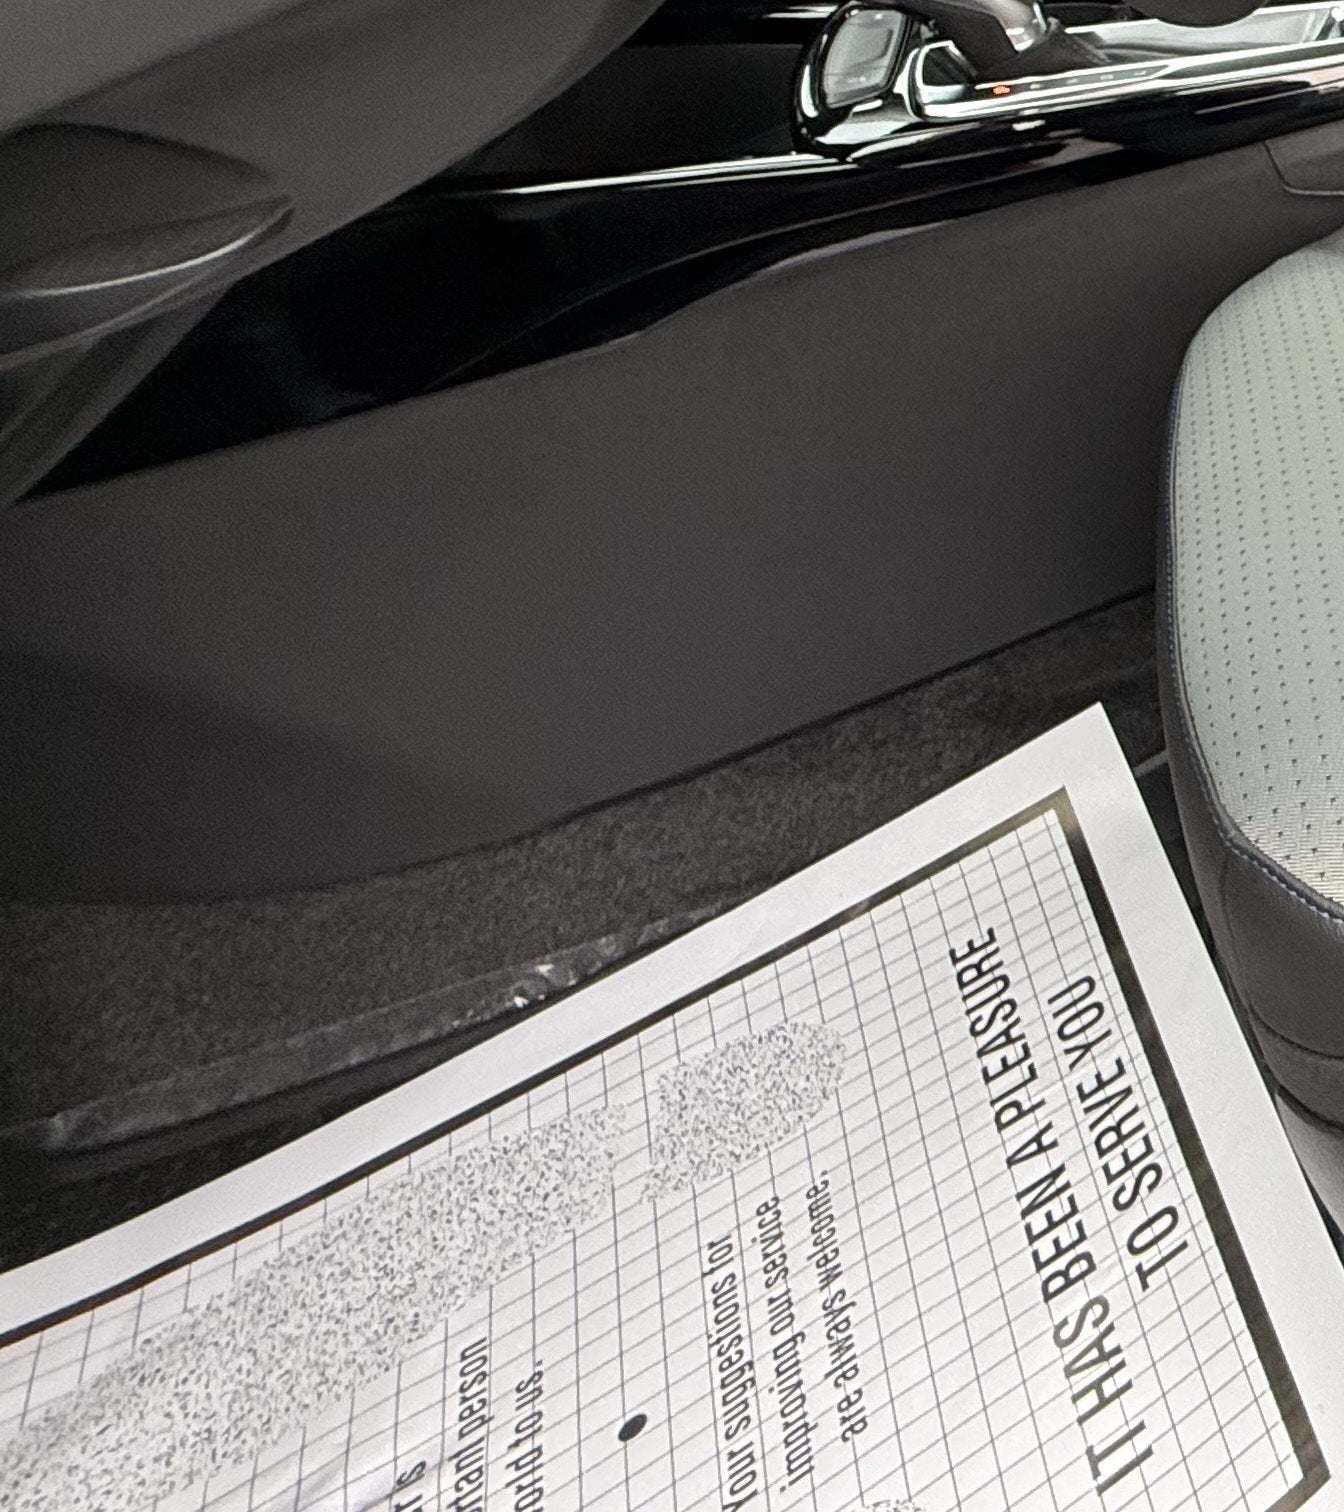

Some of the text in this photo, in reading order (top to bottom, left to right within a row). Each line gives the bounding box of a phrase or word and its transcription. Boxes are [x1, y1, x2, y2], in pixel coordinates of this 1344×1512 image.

[950, 928, 1154, 1497] IT HAS BEEN A PLEASURE
[1047, 975, 1189, 1292] TO SERVE YOU
[458, 1336, 495, 1441] person
[505, 1359, 544, 1512] orld to us.
[701, 1233, 758, 1512] Your suggestions for
[752, 1195, 819, 1492] improving our service
[805, 1169, 868, 1444] are always welcome.
